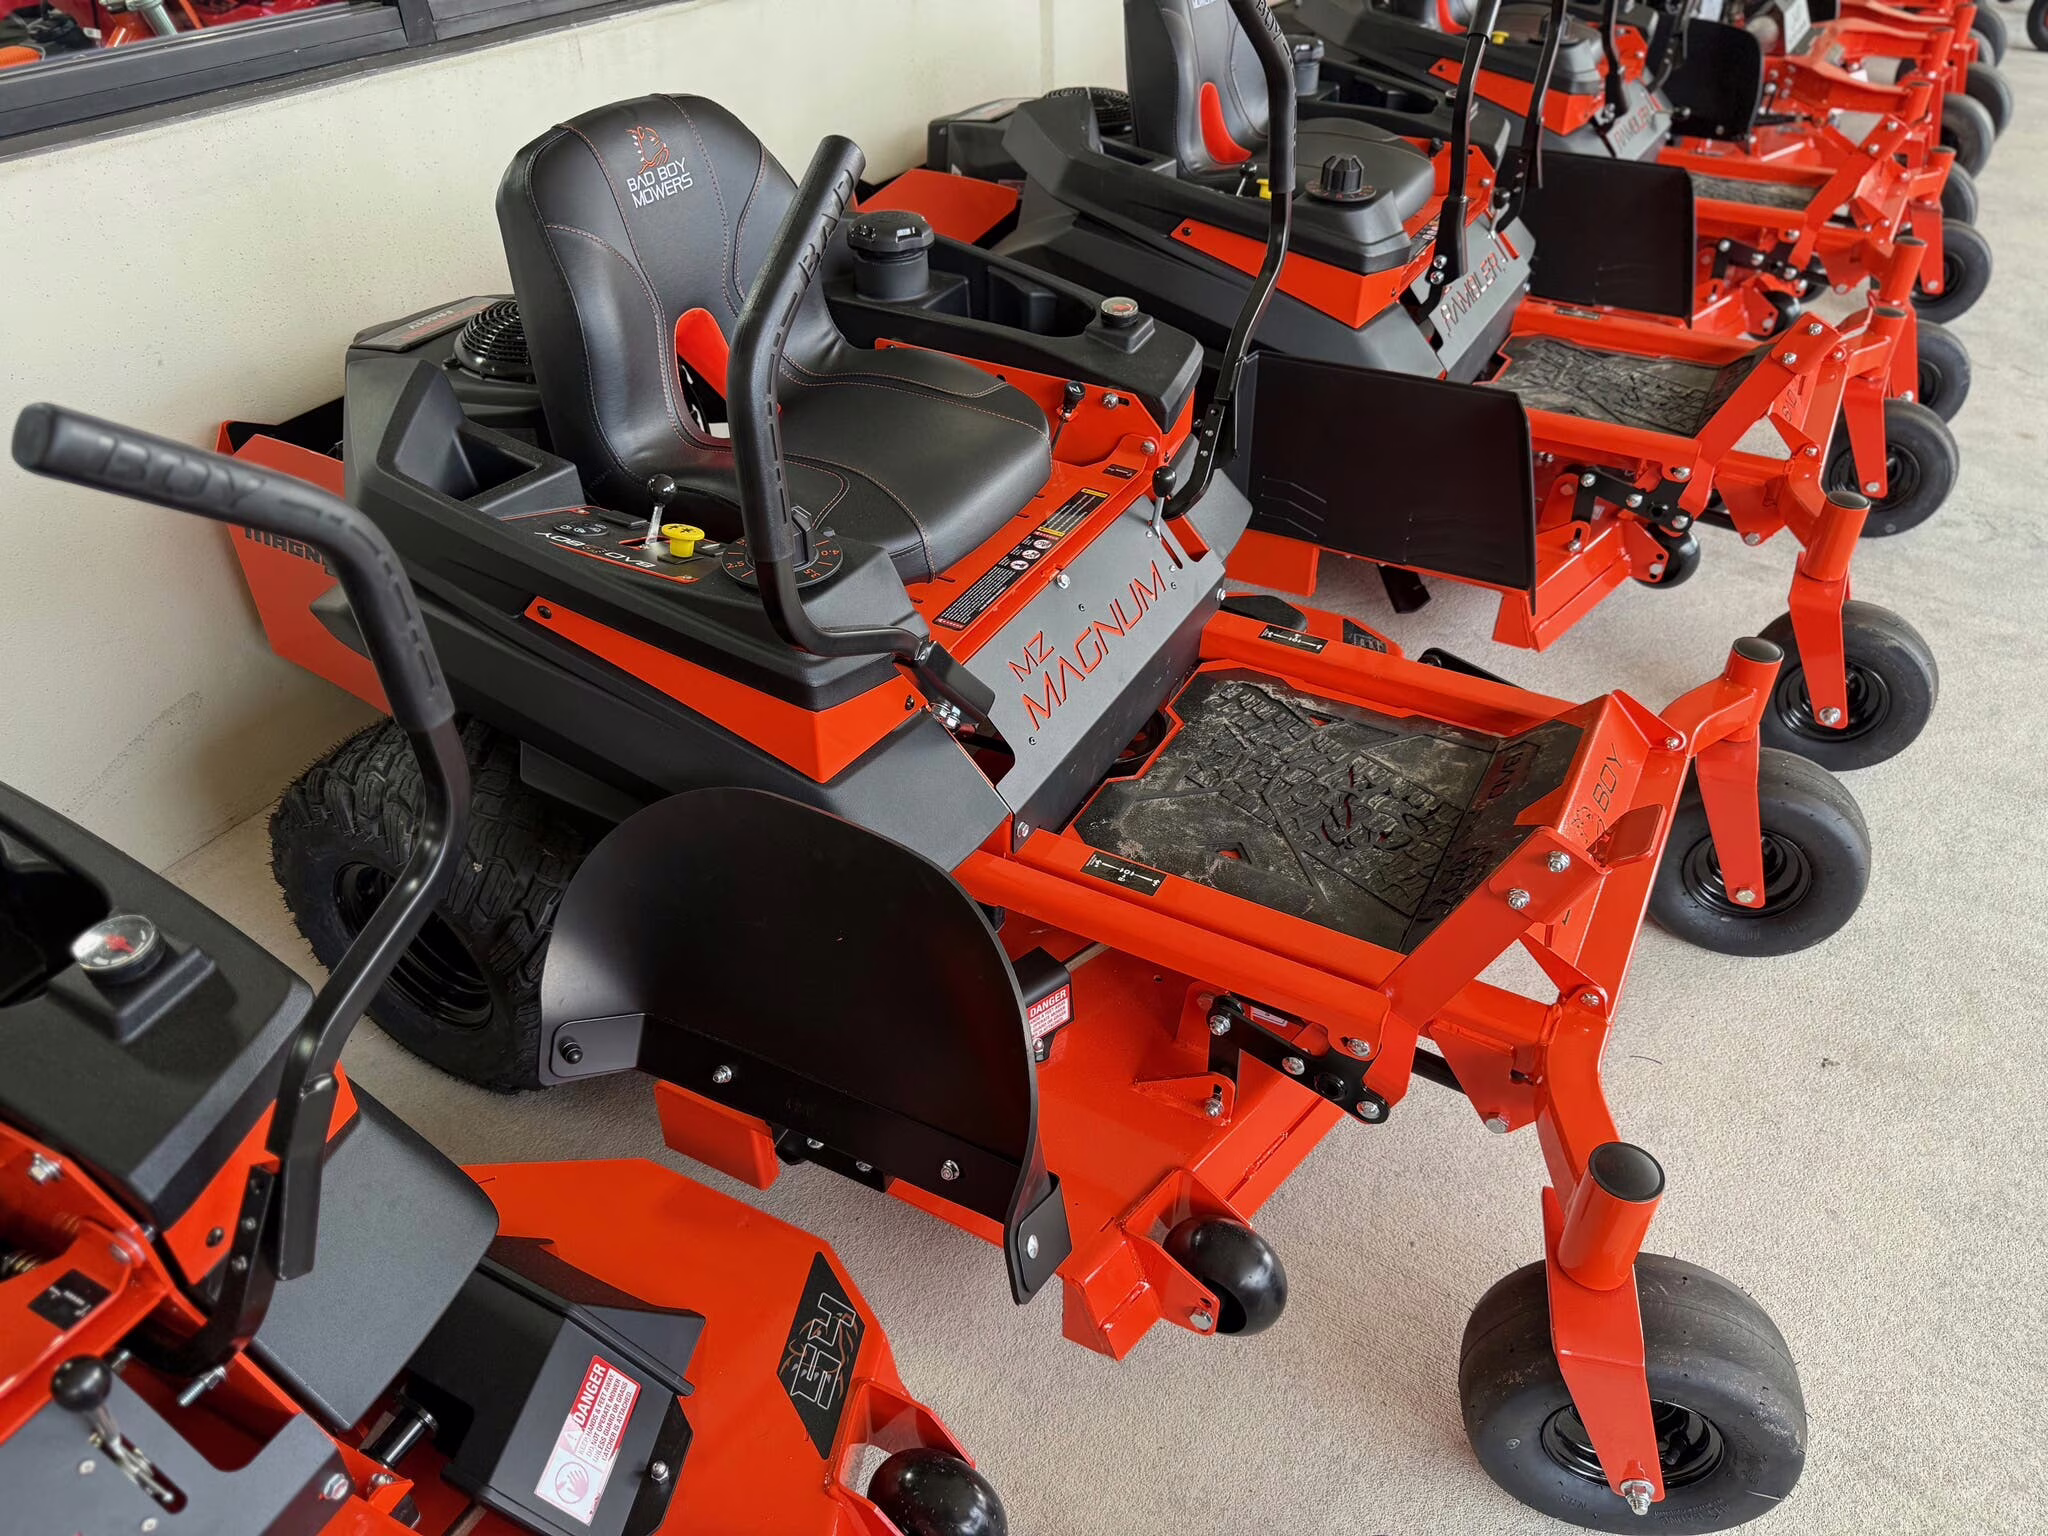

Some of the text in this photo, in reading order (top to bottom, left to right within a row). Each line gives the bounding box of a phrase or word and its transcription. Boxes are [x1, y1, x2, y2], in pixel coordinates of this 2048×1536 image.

[626, 157, 686, 193] BAD BOY
[631, 172, 694, 209] MOWERS
[1439, 251, 1503, 334] RAMBLER
[97, 432, 267, 510] BOY
[533, 531, 657, 569] BAD BOY
[1006, 630, 1056, 684] MZ
[1021, 560, 1170, 733] MAGNUM
[1592, 743, 1623, 814] BOY
[1030, 989, 1067, 1018] DANGER
[572, 1364, 606, 1426] DANGER
[586, 1414, 598, 1436] HANDS
[597, 1393, 607, 1408] FEET
[604, 1374, 615, 1392] AWAY.
[590, 1431, 600, 1446] NOT
[596, 1403, 612, 1431] OPERATE
[608, 1378, 622, 1403] MOWER
[603, 1413, 616, 1436] GUARD
[612, 1403, 620, 1414] OR
[616, 1382, 628, 1403] GRASS
[602, 1432, 616, 1461] CATCHER
[617, 1392, 632, 1424] ATTACHED.
